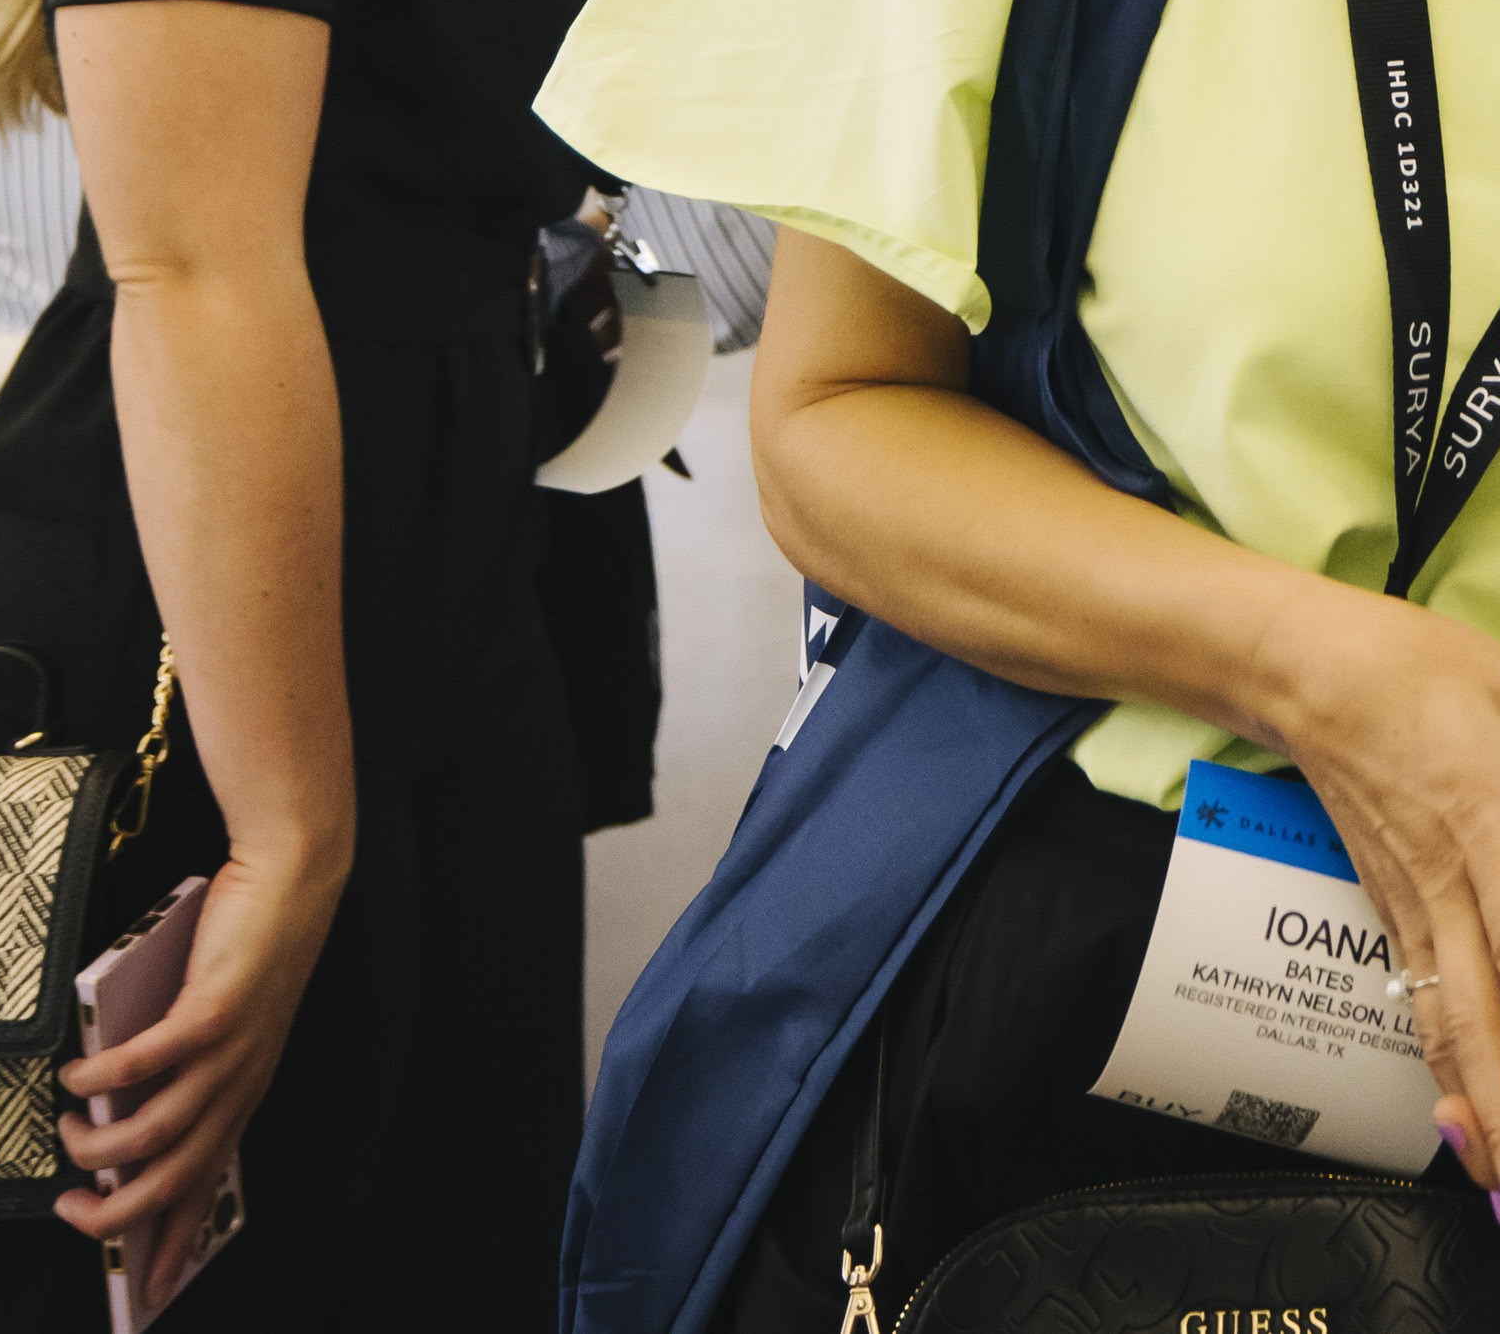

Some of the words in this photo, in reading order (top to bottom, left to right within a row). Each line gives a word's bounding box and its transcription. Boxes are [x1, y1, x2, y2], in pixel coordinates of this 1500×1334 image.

[1386, 59, 1413, 129] IHDC
[1397, 141, 1424, 231] 1D321
[1405, 320, 1432, 477] SURYA
[1239, 816, 1316, 848] DALLAS
[1264, 906, 1392, 973] IOANA
[1192, 962, 1294, 1004] KATHRYN
[1297, 989, 1387, 1031] NELSON,
[1285, 959, 1355, 994] BATES
[1174, 982, 1278, 1022] REGISTERED
[1280, 1011, 1356, 1042] INTERIOR
[1256, 1023, 1319, 1053] DALLAS,
[1325, 1042, 1347, 1060] TX
[1180, 1307, 1329, 1334] GUESS
